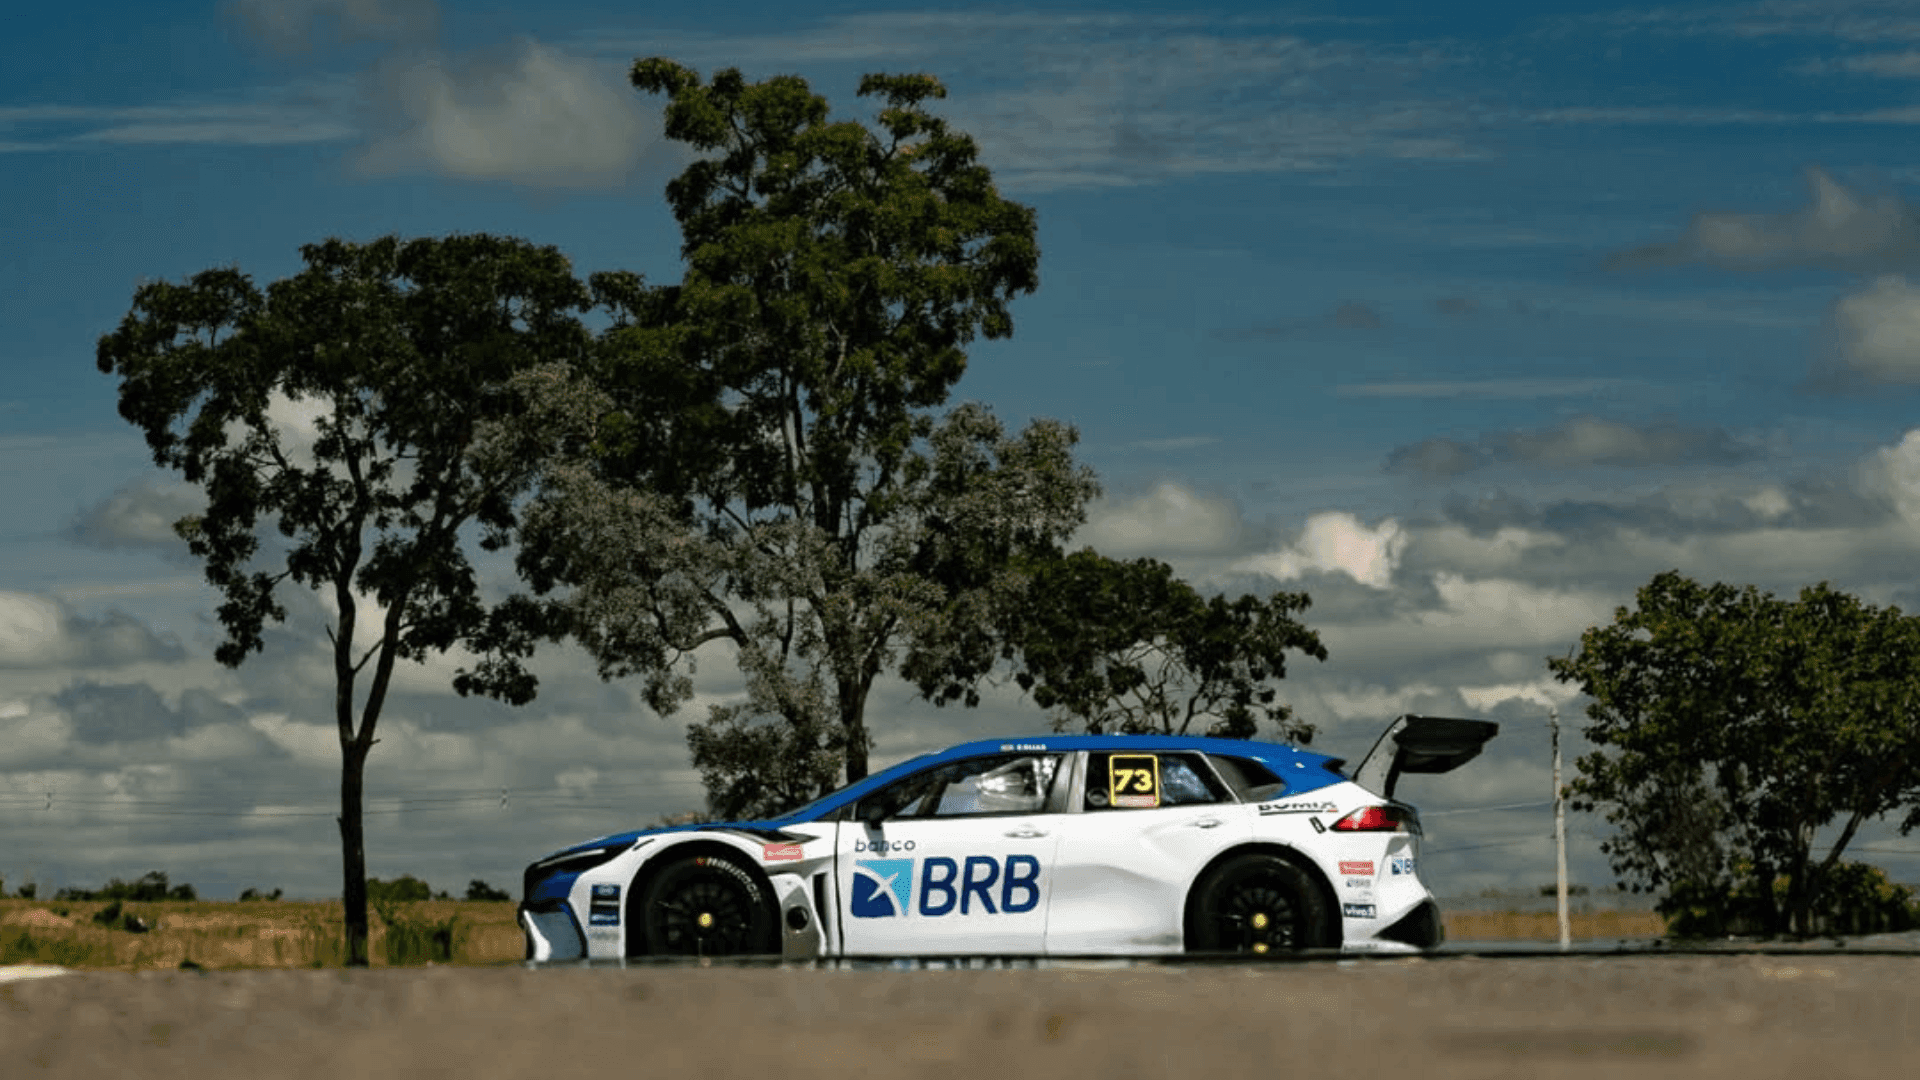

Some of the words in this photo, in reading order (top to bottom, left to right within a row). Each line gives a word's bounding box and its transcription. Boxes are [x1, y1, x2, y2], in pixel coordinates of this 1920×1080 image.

[1114, 769, 1153, 792] 73
[854, 838, 916, 853] banco
[919, 854, 1041, 917] BRB
